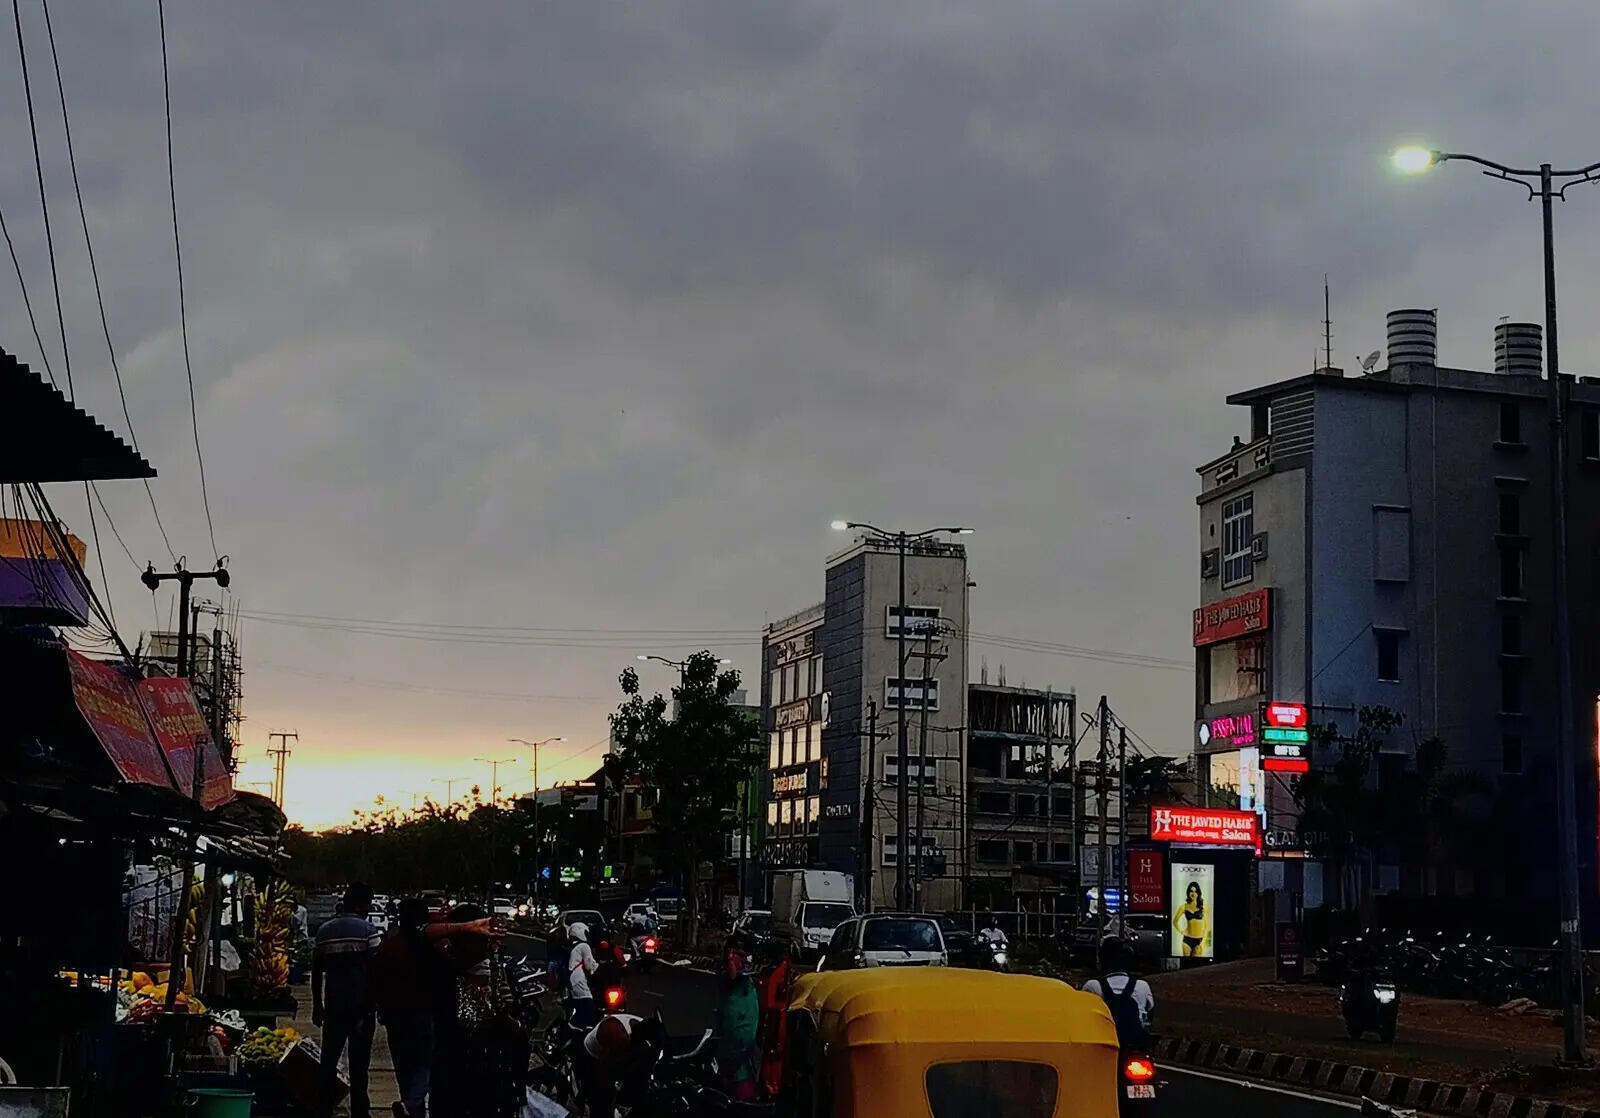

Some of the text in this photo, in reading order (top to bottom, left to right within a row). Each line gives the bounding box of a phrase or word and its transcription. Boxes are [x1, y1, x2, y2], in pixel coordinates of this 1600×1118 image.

[1171, 814, 1252, 830] THE JAWED HABIB
[1222, 828, 1251, 841] Salon
[1133, 892, 1161, 904] Salon
